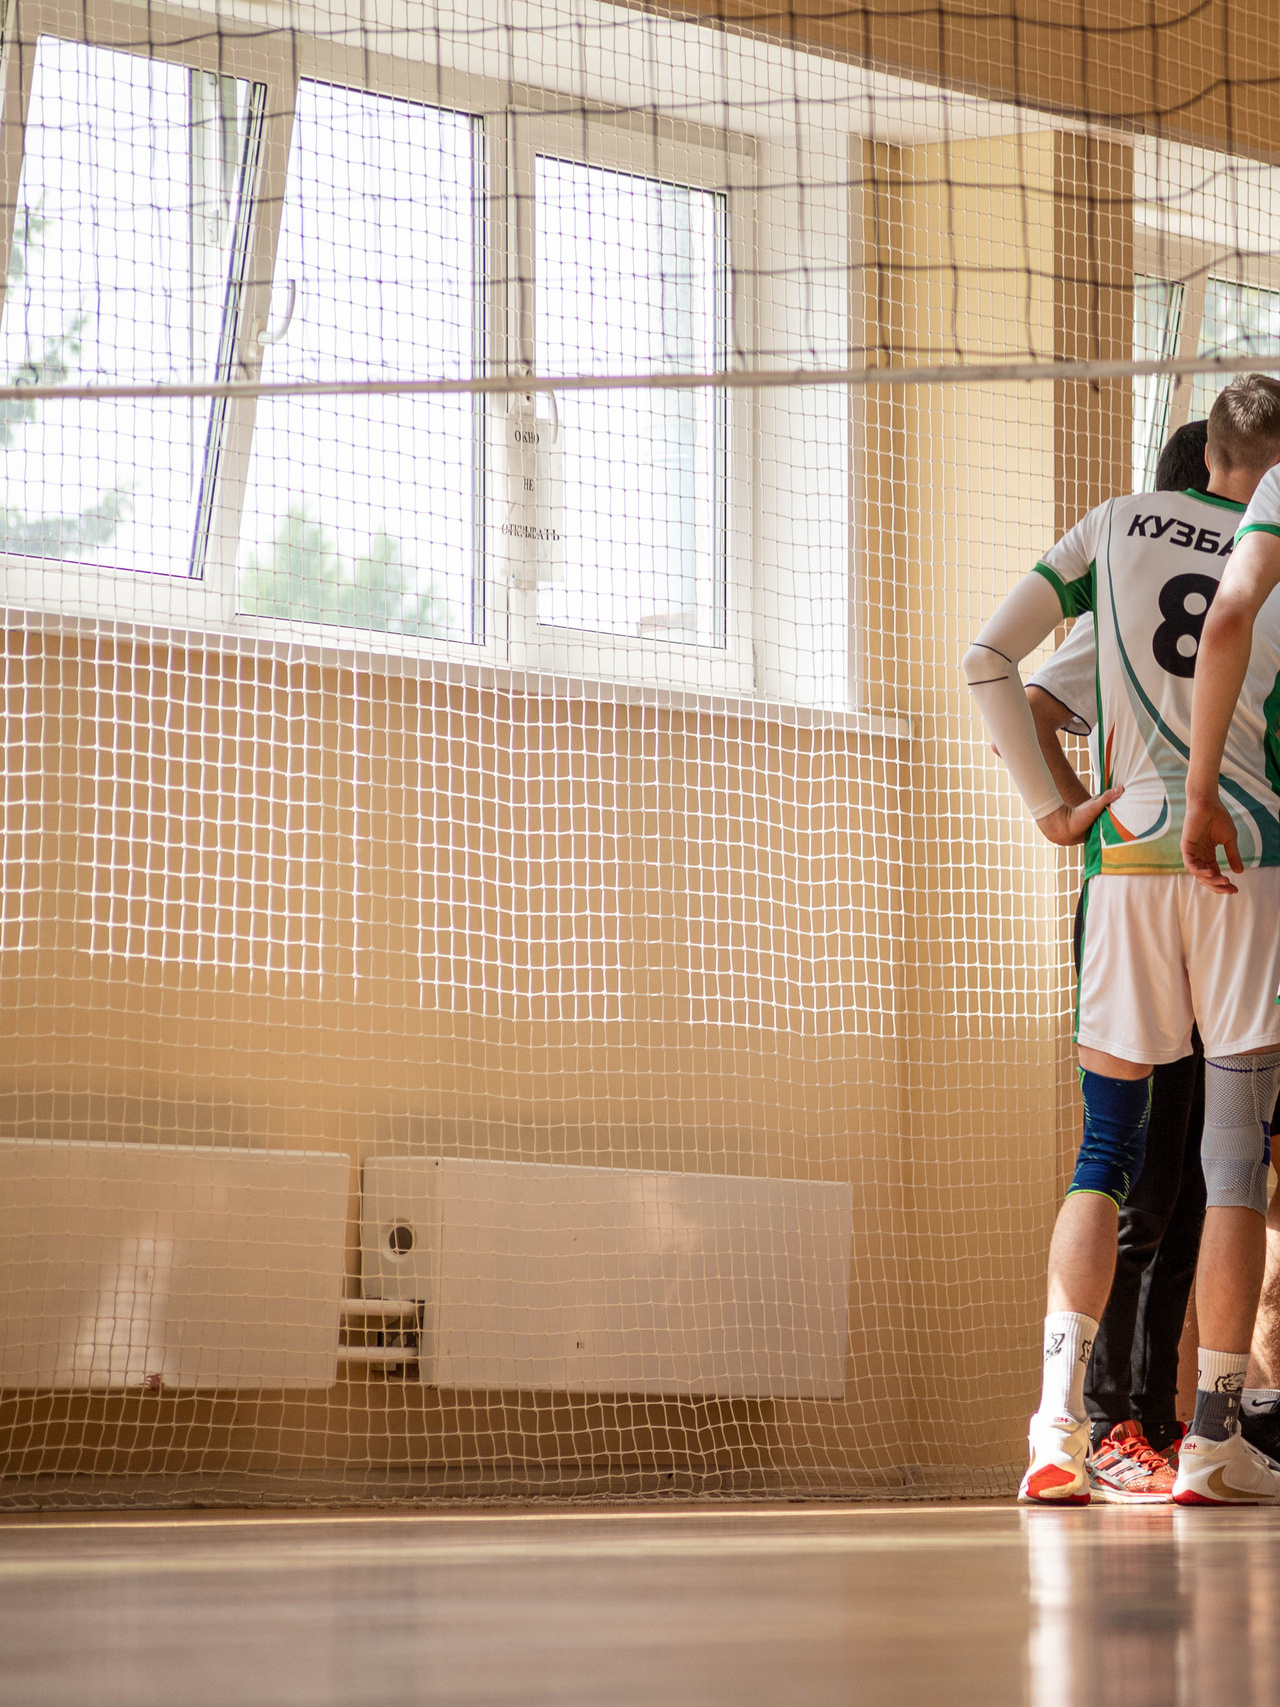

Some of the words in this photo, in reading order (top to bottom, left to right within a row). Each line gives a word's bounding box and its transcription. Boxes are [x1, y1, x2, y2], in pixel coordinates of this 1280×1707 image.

[515, 430, 540, 445] ОКНО
[523, 478, 535, 491] НЕ
[1152, 573, 1221, 679] 8
